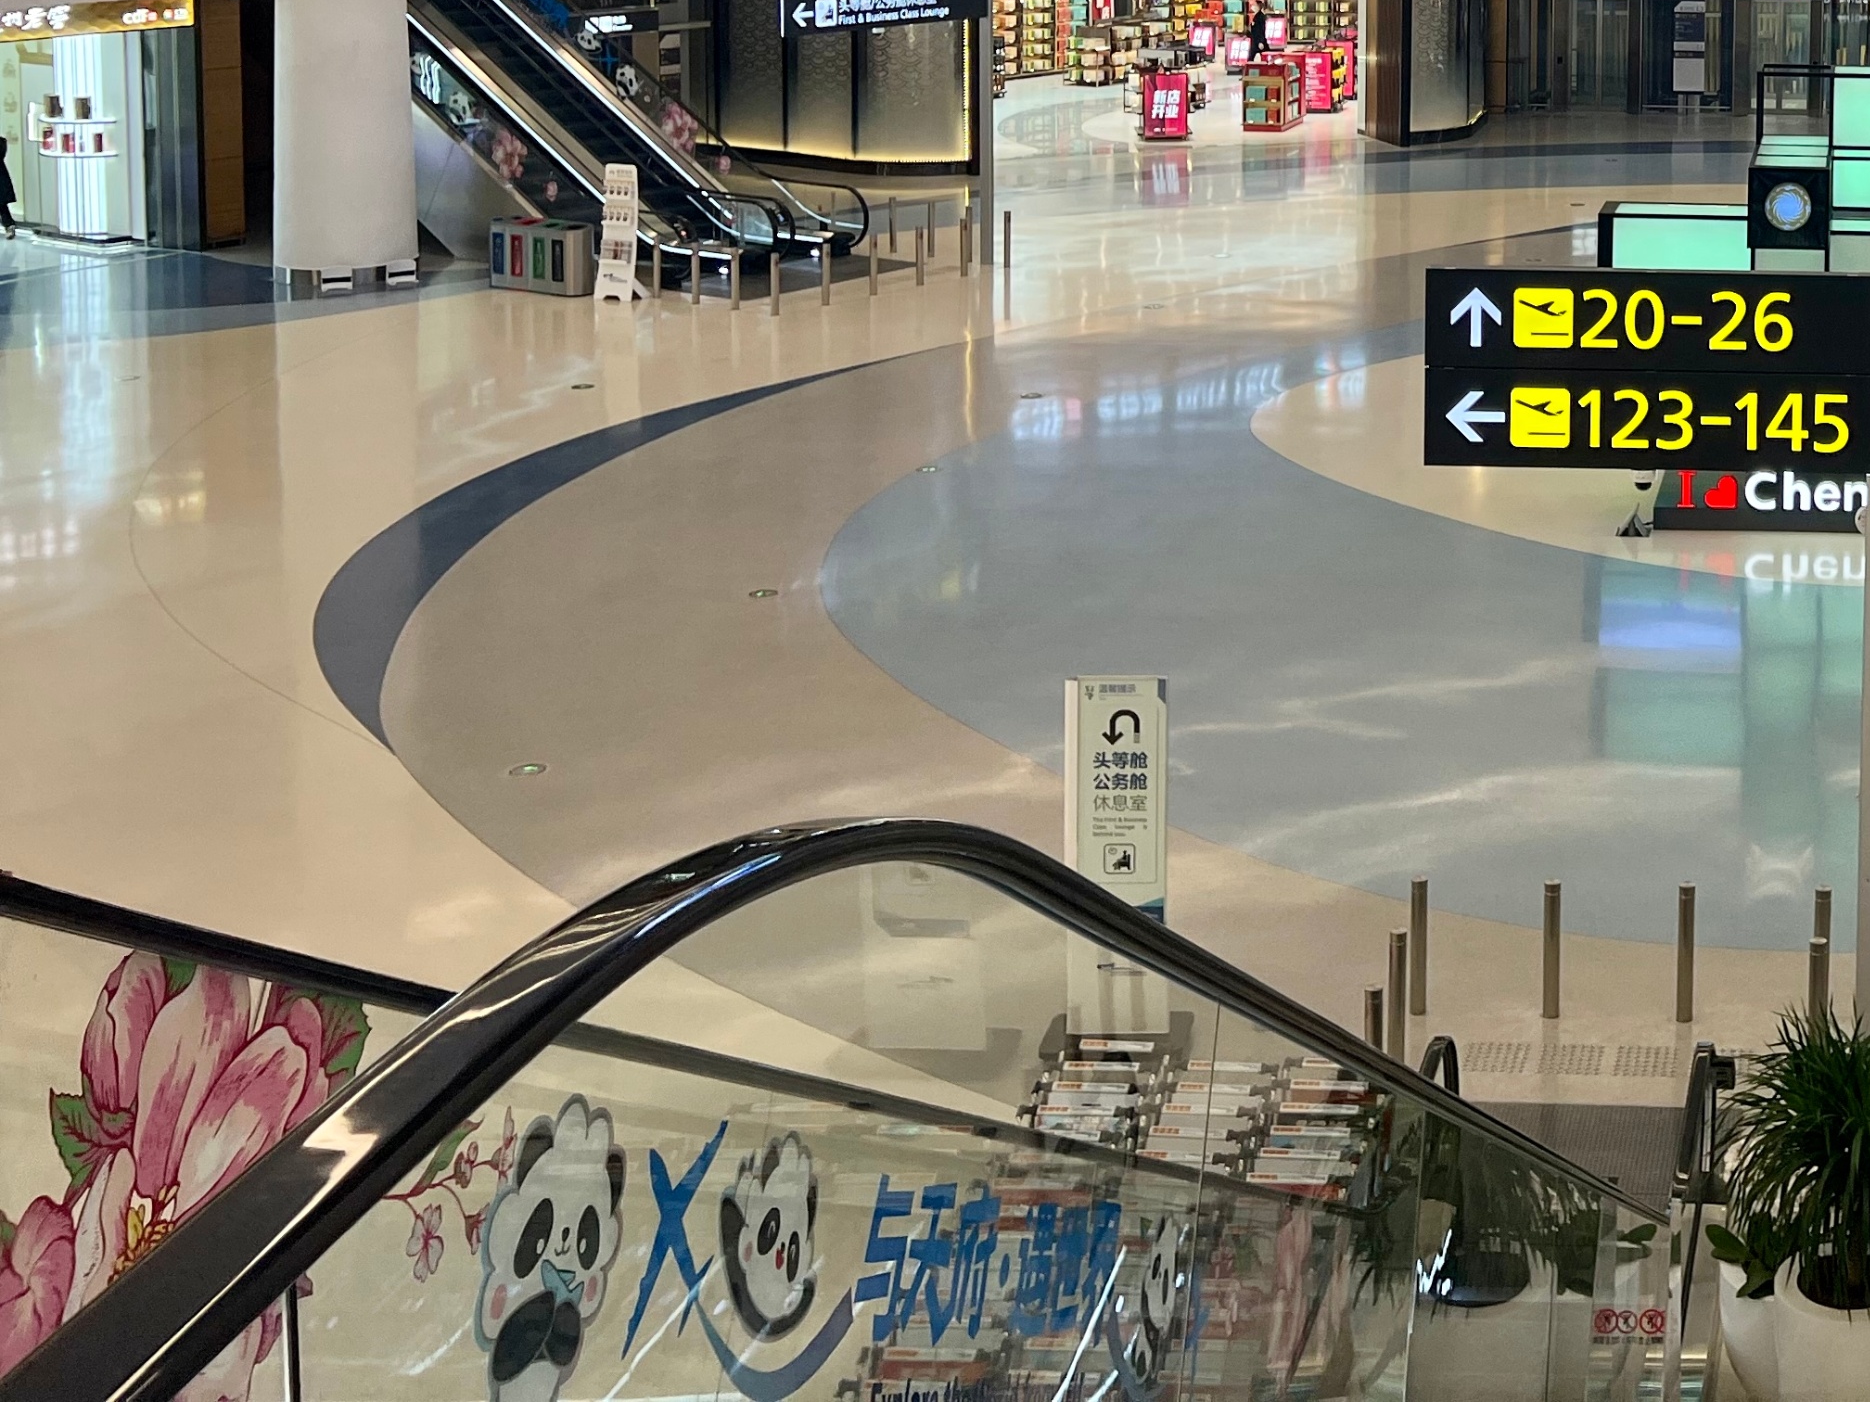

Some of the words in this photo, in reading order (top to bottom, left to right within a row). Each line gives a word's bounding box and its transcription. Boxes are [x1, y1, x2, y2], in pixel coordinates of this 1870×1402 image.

[838, 13, 856, 26] First
[858, 12, 865, 24] &
[866, 10, 899, 23] Business
[900, 8, 919, 19] Class
[920, 6, 950, 20] Lounge
[1151, 105, 1179, 119] 开业
[1579, 288, 1795, 353] 20-26
[1577, 389, 1850, 454] 123-145
[1676, 470, 1696, 509] I
[1092, 751, 1148, 770] 头等舱
[1092, 772, 1148, 791] 公务舱
[1092, 794, 1148, 812] 休息室
